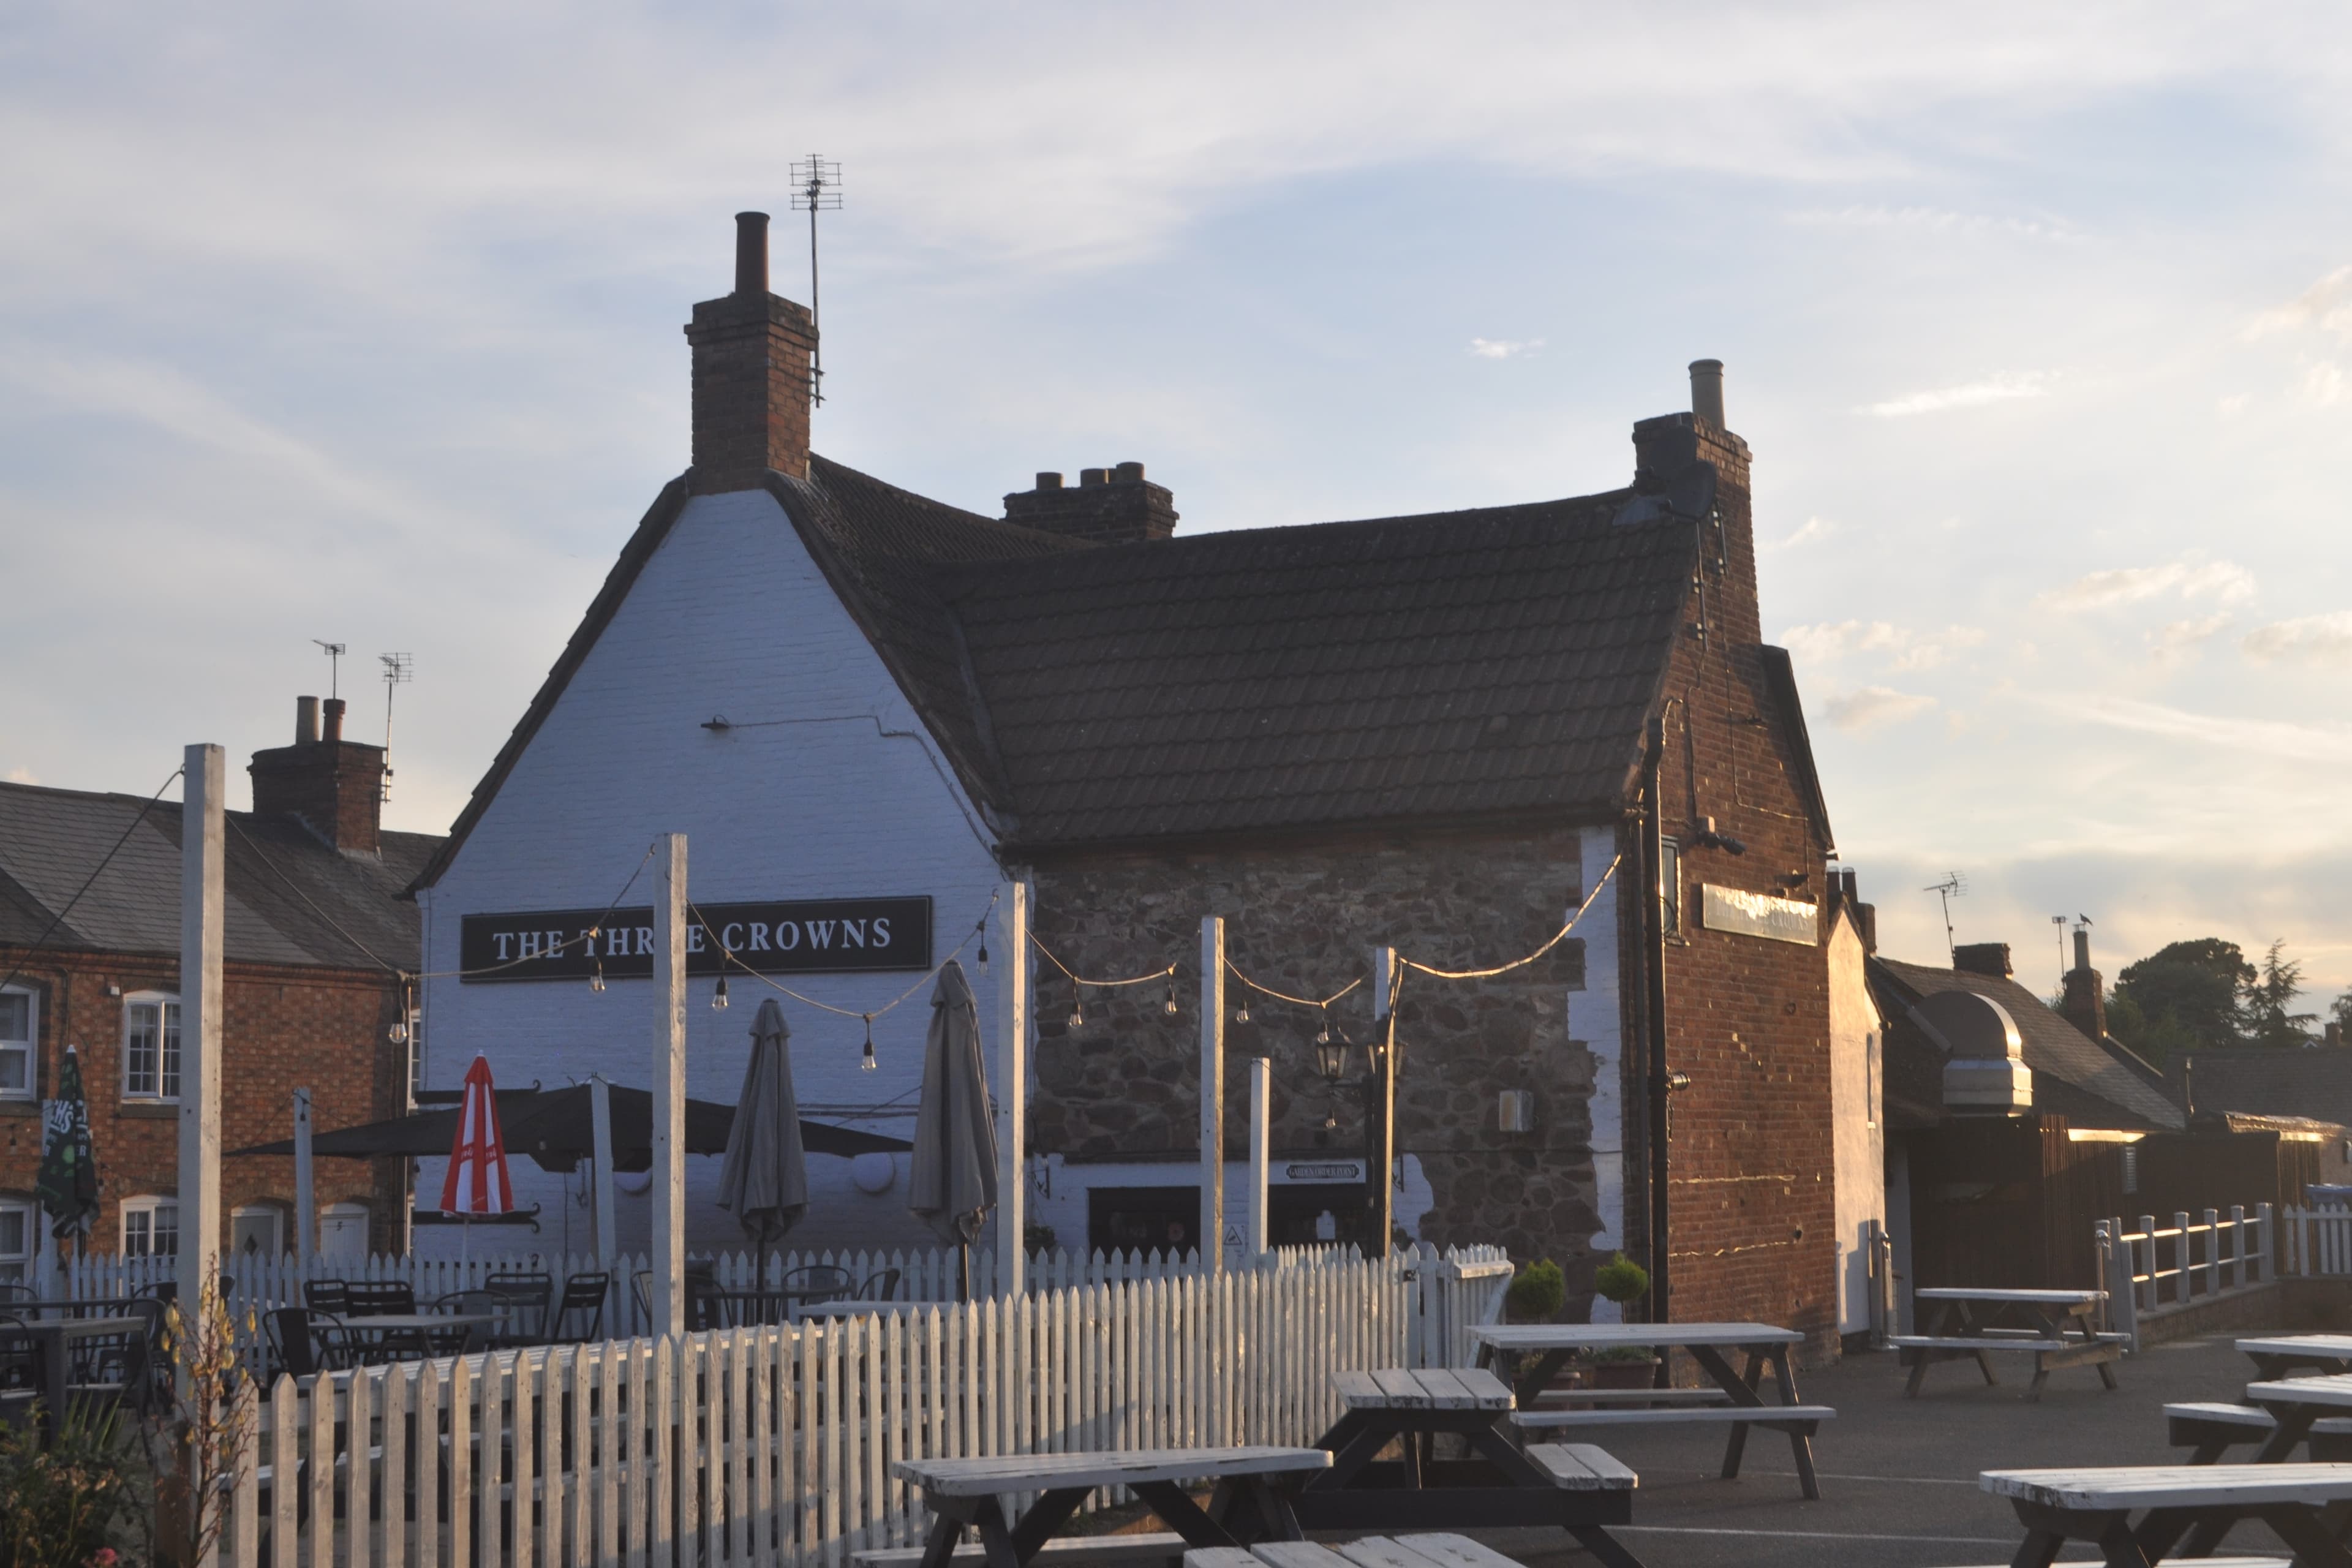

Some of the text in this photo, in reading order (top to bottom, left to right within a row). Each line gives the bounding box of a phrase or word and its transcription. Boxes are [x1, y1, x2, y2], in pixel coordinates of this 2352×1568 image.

[492, 918, 891, 960] THE THRE CROWNS
